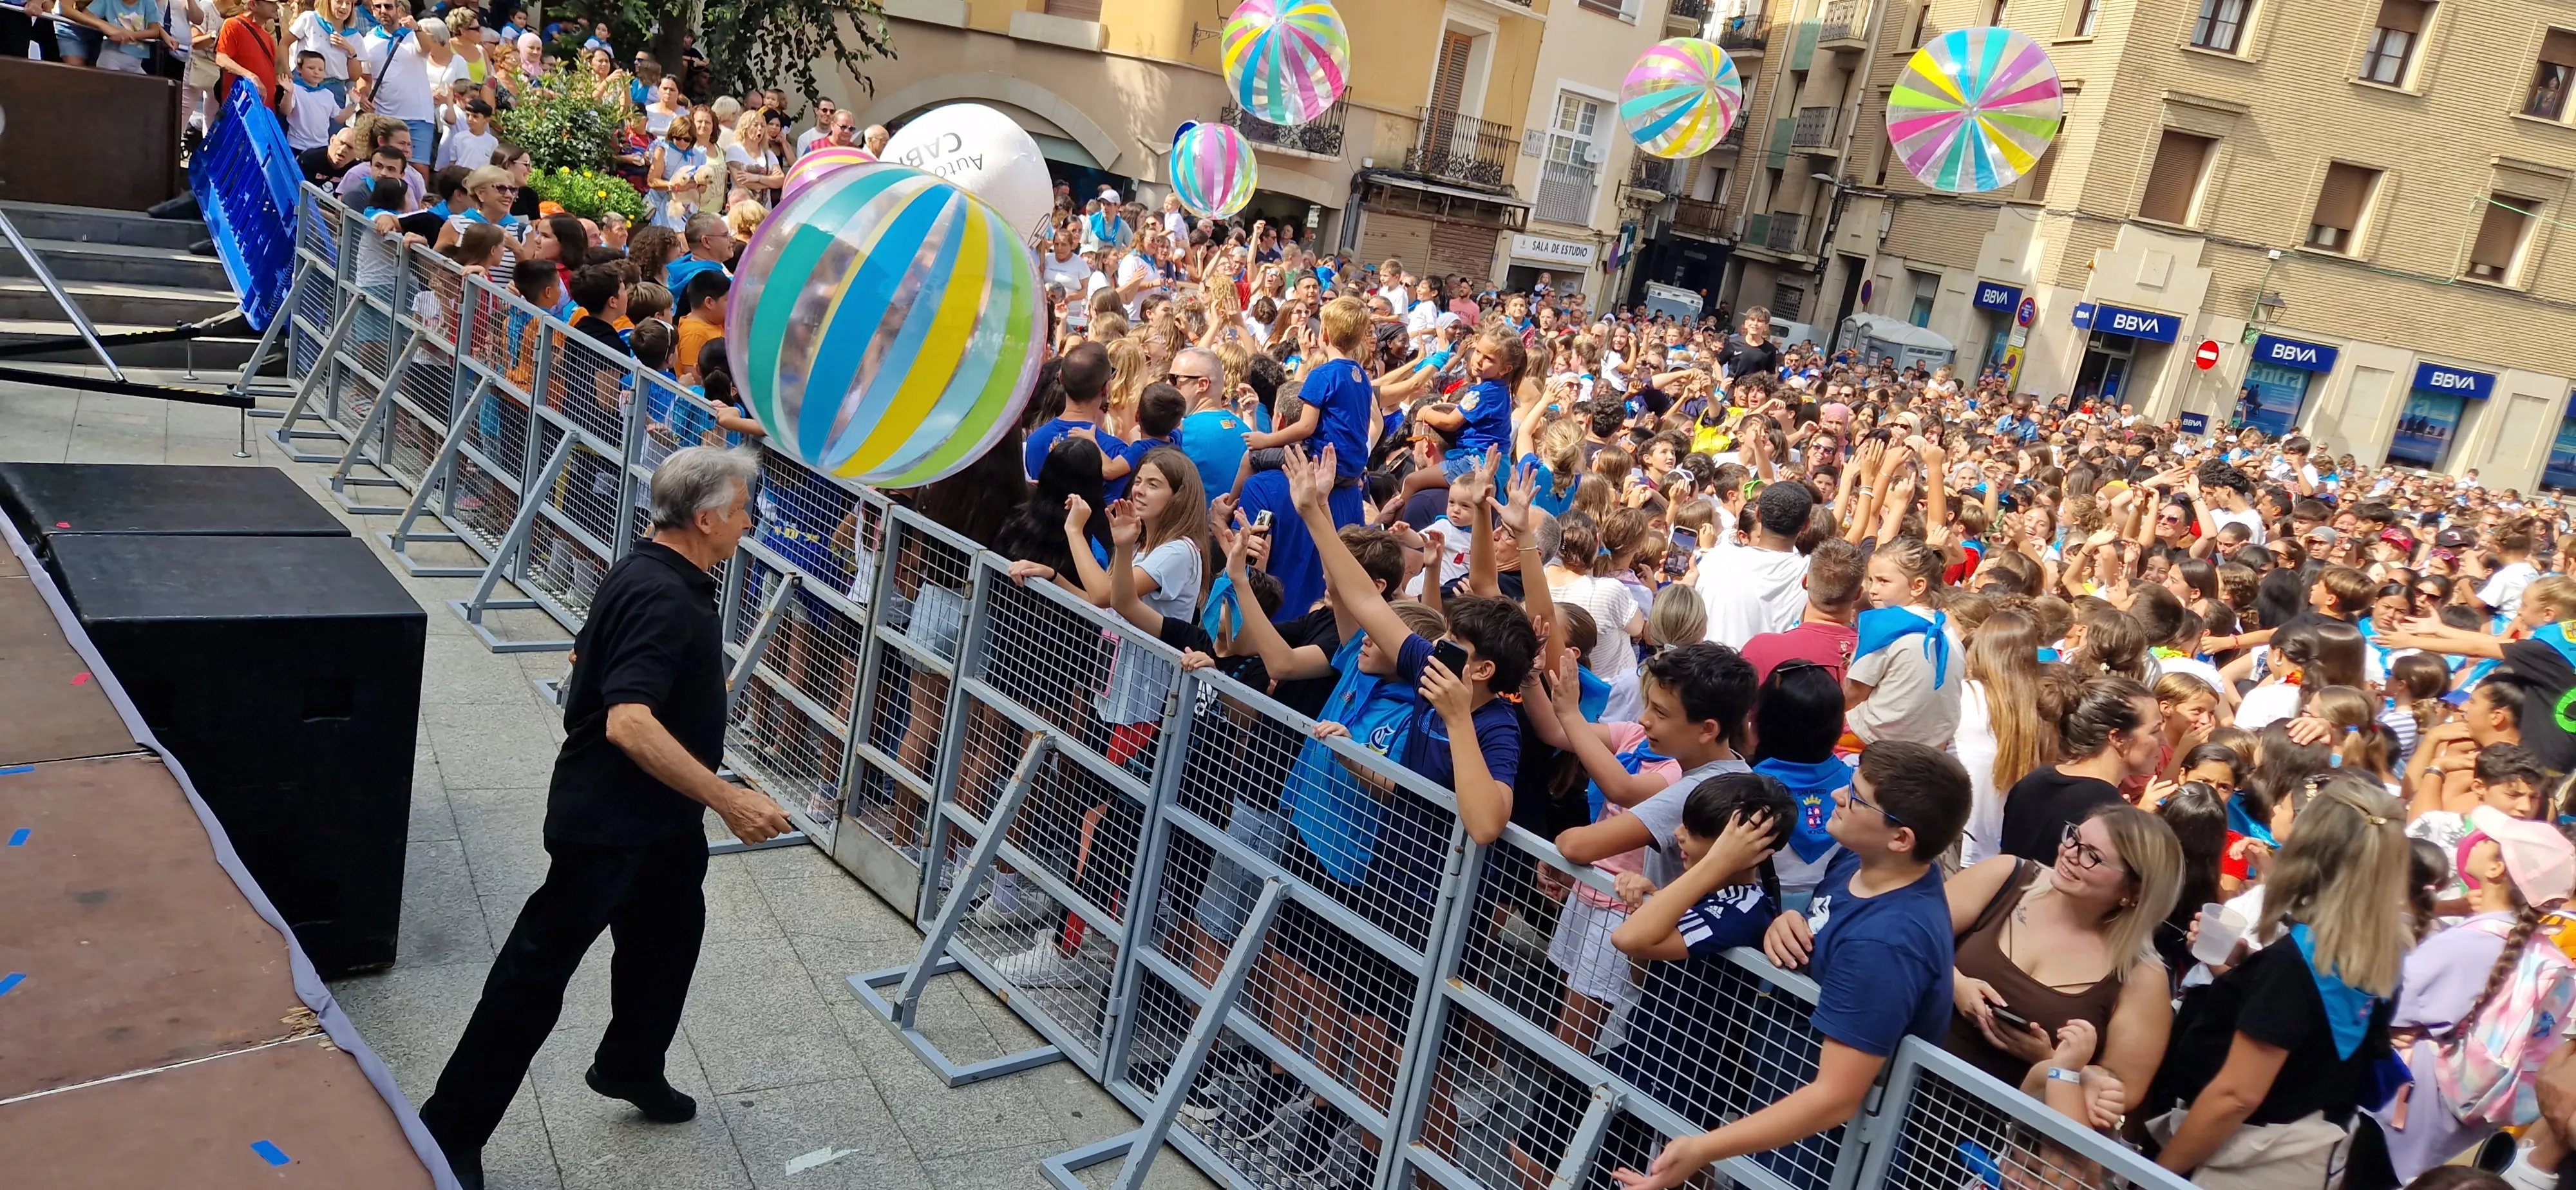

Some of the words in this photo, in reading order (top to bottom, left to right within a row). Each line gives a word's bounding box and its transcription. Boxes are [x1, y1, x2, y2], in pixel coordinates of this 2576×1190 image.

[1532, 240, 1549, 252] SALA
[1551, 243, 1560, 254] DE
[1560, 245, 1587, 257] ESTUDIO
[1982, 288, 2008, 305] BBVA
[2076, 310, 2089, 319] BBVA
[2113, 314, 2159, 333] BBVA
[2271, 343, 2317, 363] BBVA
[2248, 362, 2304, 389] Entra
[2430, 372, 2475, 390] BBVA
[2183, 419, 2202, 427] BBVA
